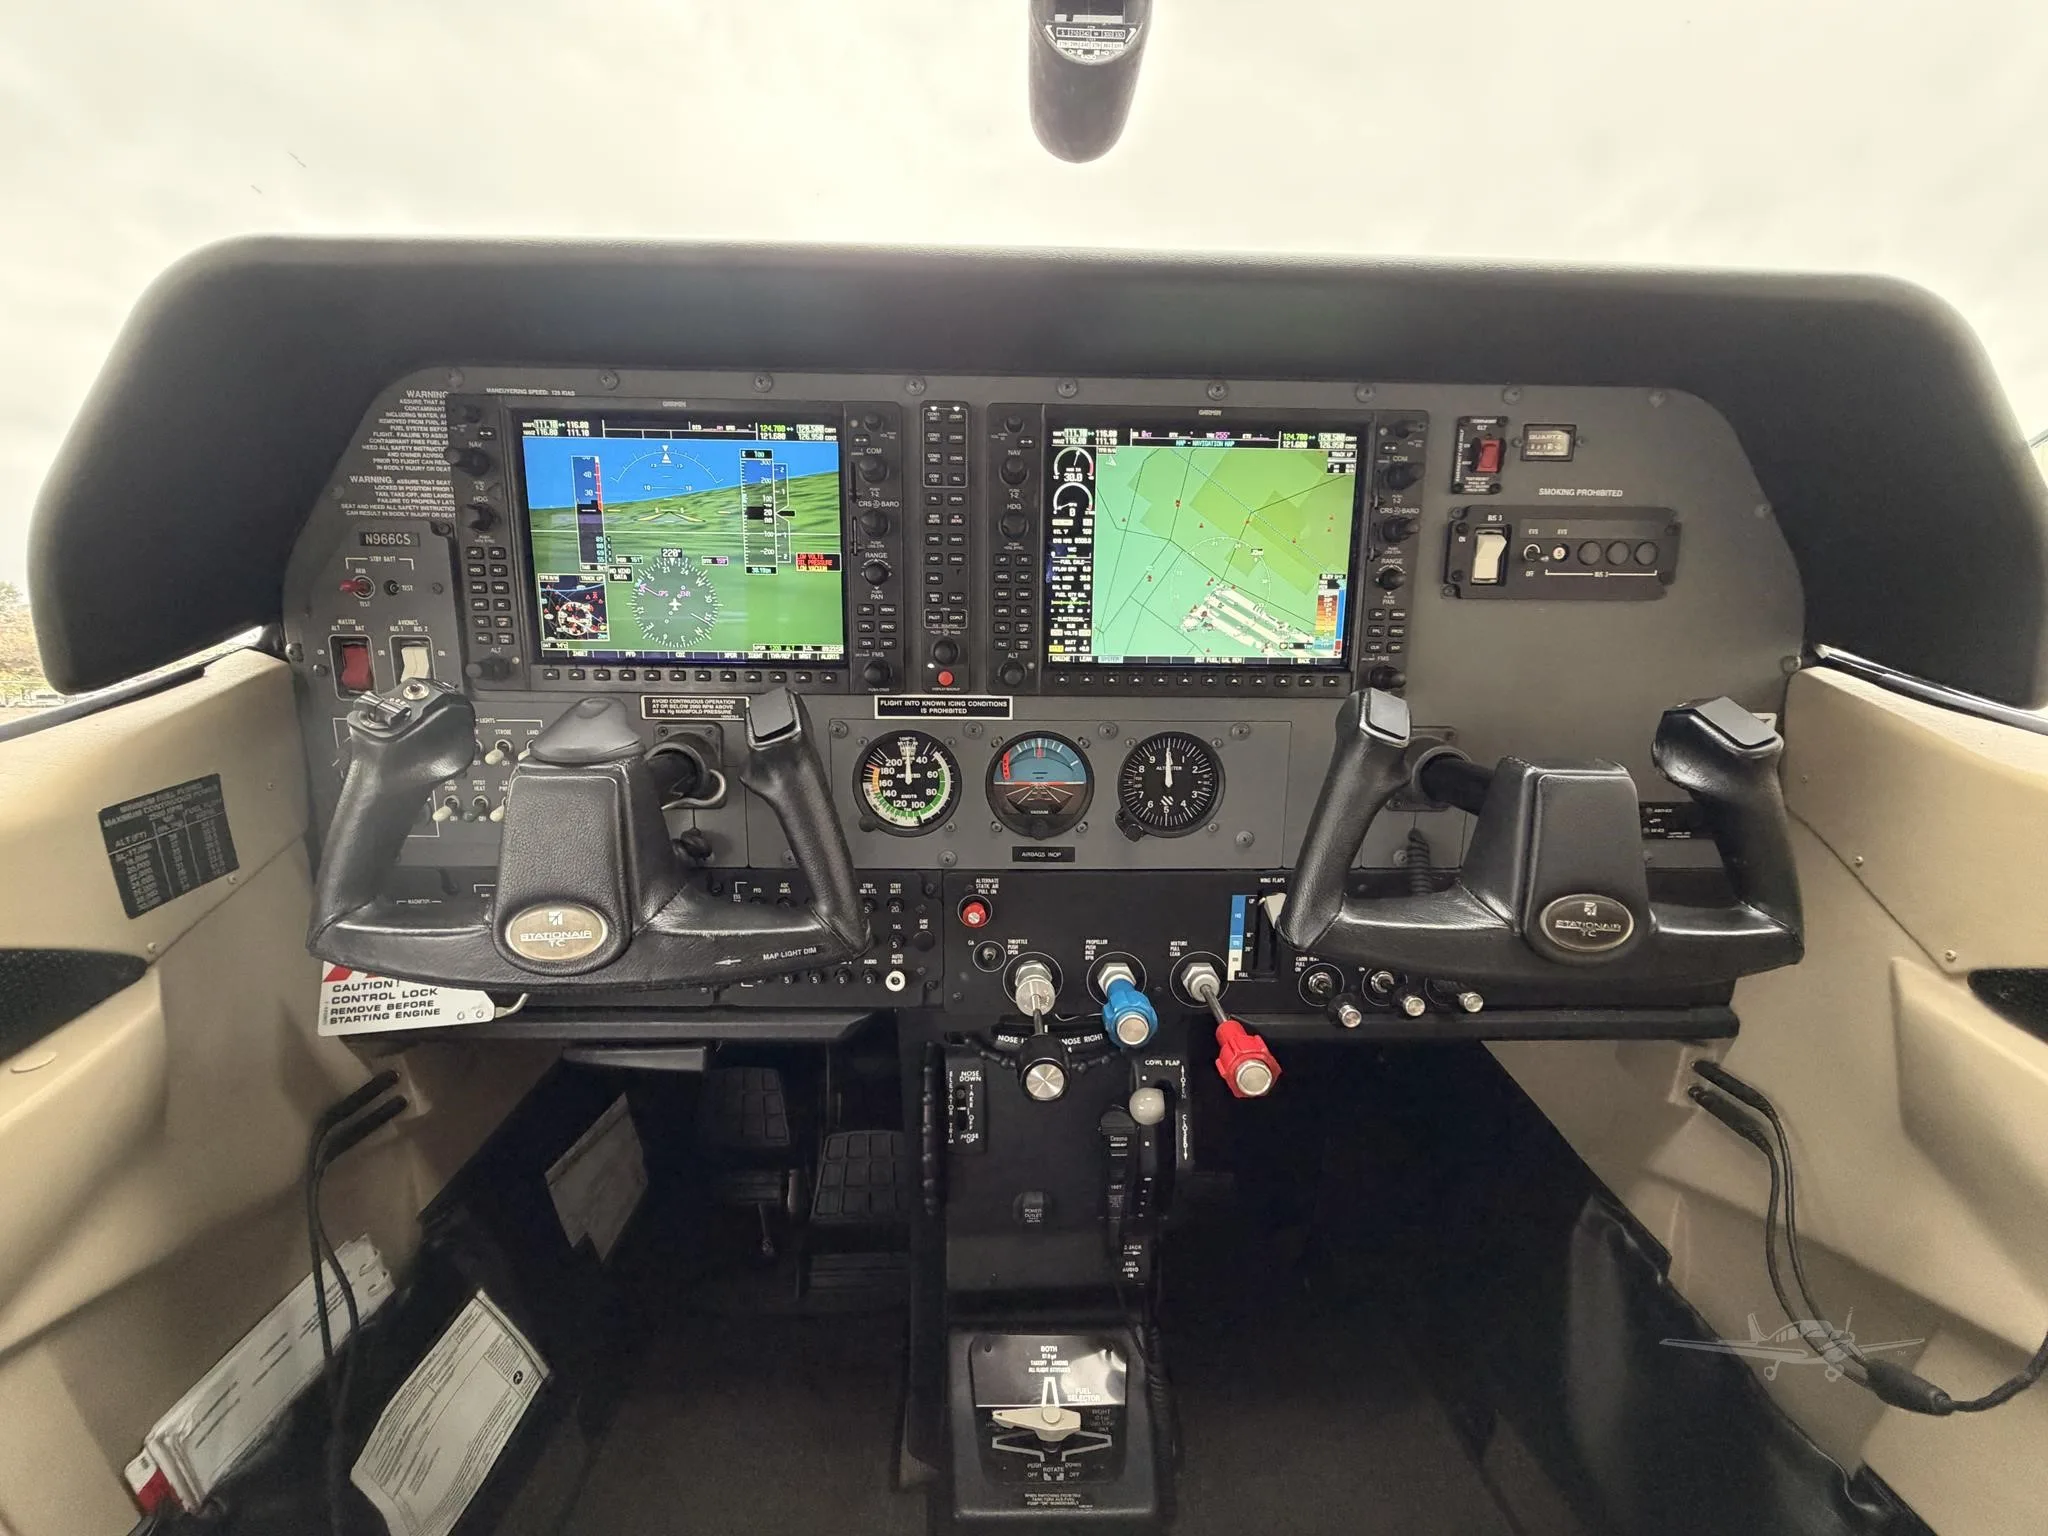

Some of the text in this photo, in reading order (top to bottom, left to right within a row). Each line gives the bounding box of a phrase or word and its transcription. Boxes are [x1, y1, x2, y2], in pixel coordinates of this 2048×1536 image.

[1556, 920, 1621, 931] STATIONAIR
[520, 930, 592, 942] STATIONAIR
[781, 949, 802, 958] LIGHT
[331, 988, 438, 1005] CONTROL LOCK
[330, 1000, 434, 1016] REMOVE BEFORE
[330, 1008, 441, 1024] STARTING ENGINE
[997, 1034, 1018, 1044] NOSE
[1084, 1034, 1103, 1043] RIGHT
